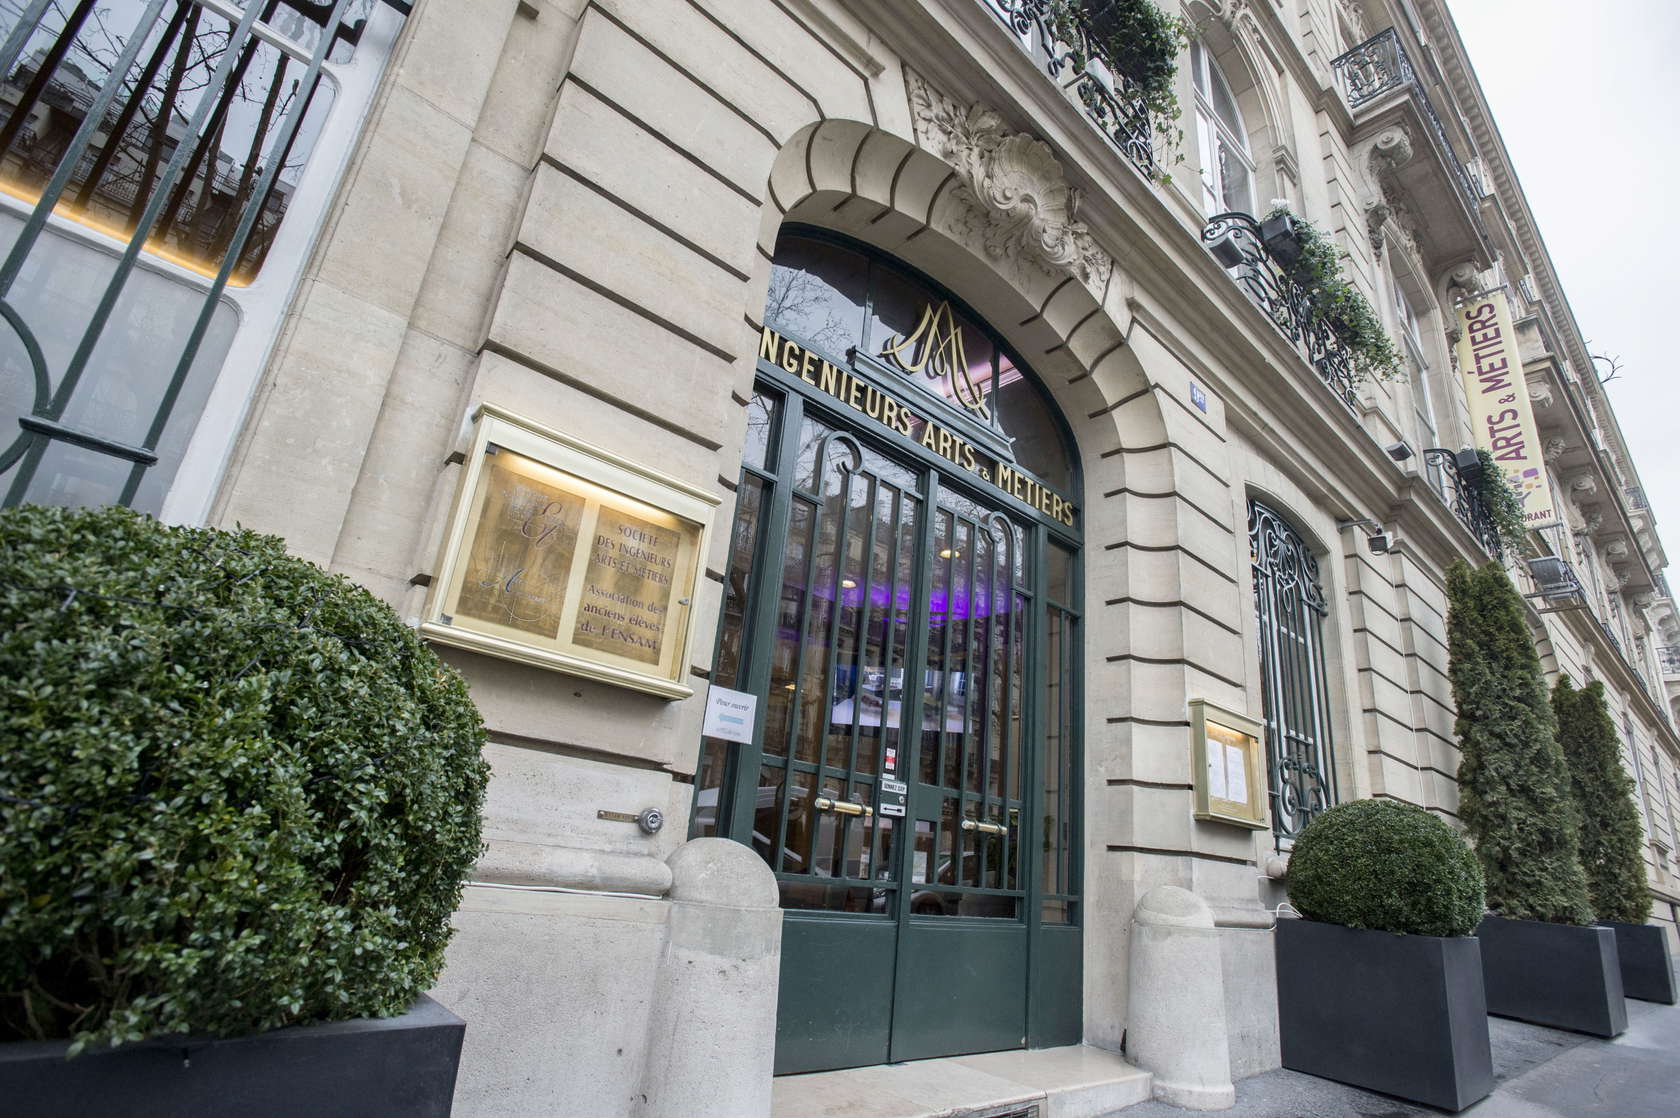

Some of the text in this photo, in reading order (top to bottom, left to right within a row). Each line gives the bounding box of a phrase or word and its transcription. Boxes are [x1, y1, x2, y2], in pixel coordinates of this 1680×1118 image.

[1465, 302, 1528, 462] ARTS & MÉTIERS
[760, 326, 1074, 527] NGENIEURS ARTS & METIERS
[1519, 508, 1552, 523] URANT
[597, 535, 616, 551] DES
[594, 552, 617, 569] ARTS
[586, 583, 645, 609] Association
[583, 602, 626, 622] anciens
[580, 619, 597, 633] de
